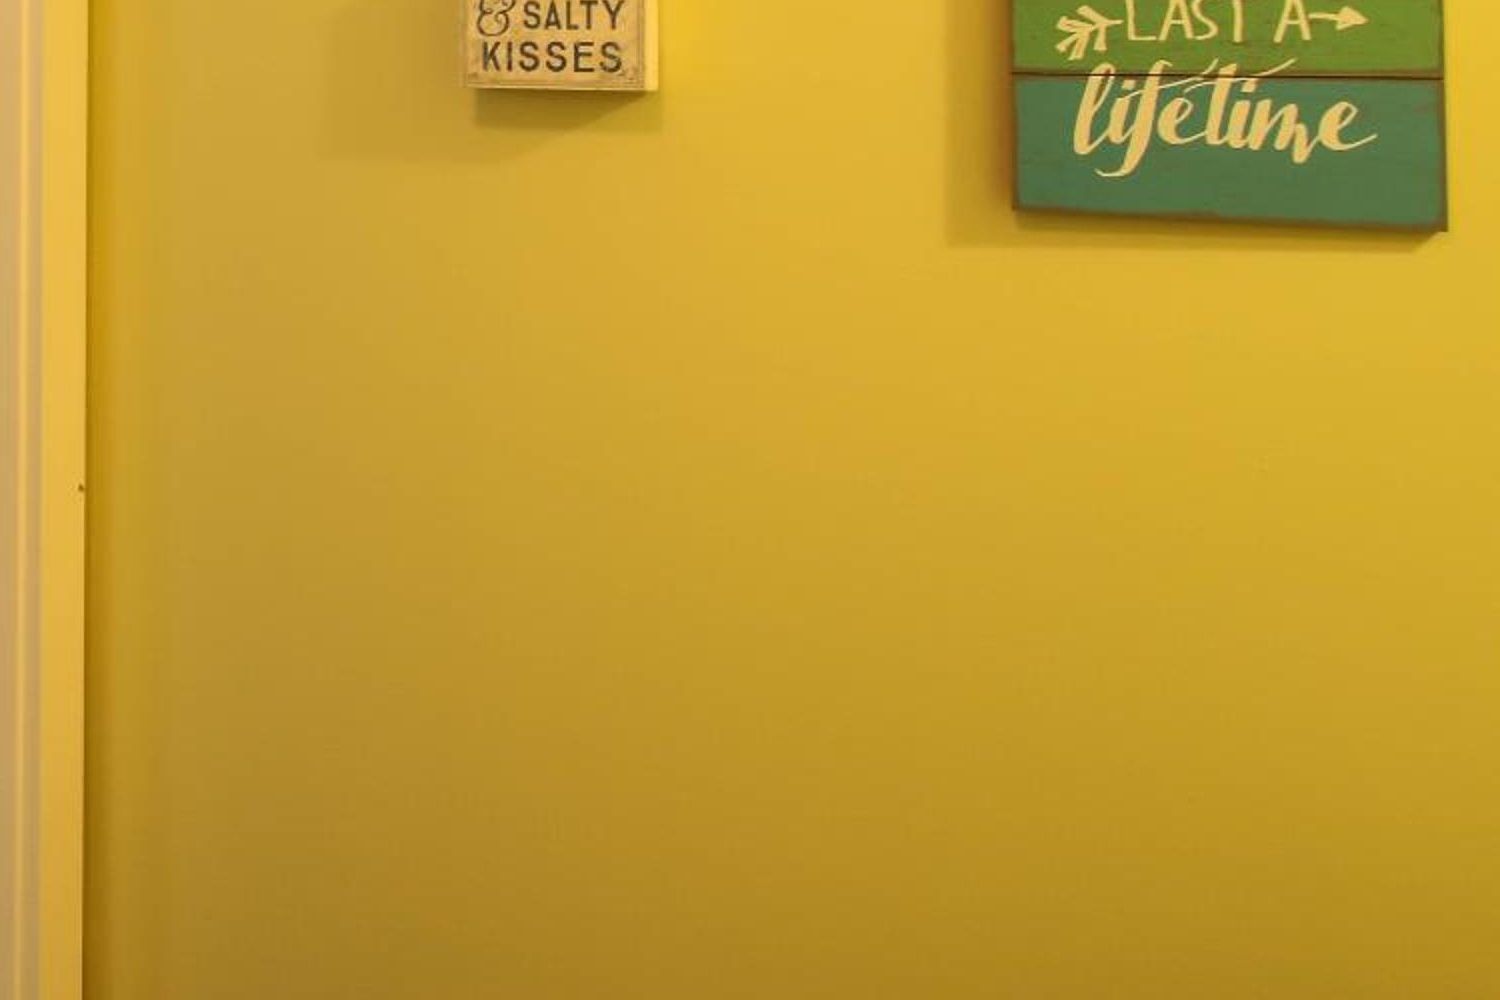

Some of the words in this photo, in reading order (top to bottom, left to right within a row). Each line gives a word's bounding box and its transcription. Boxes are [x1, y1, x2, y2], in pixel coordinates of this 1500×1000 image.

[522, 0, 625, 30] SALTY
[482, 41, 623, 73] KISSES
[1072, 58, 1378, 178] lifetime
